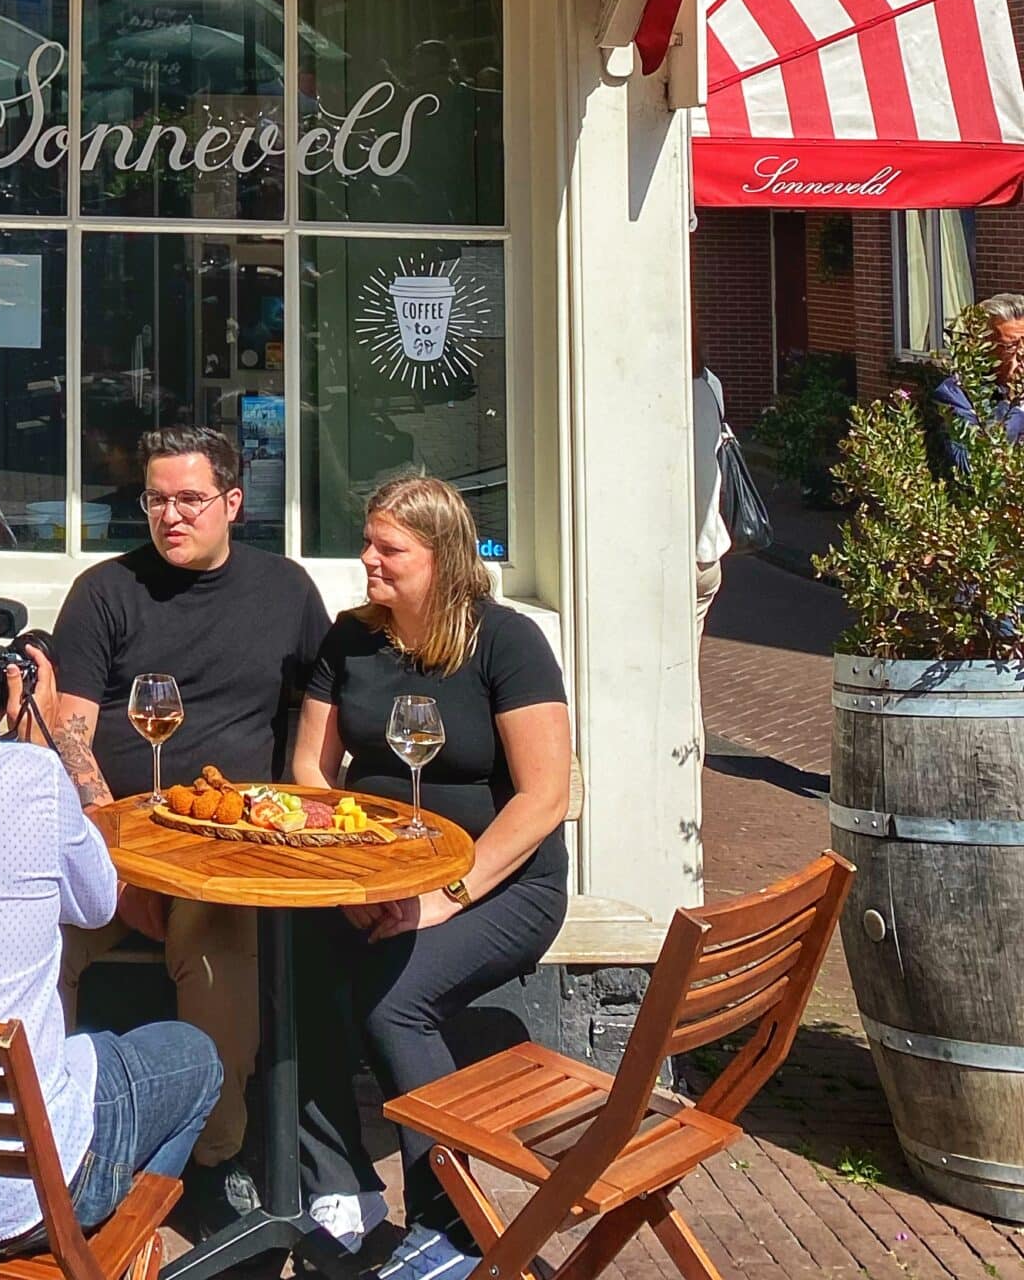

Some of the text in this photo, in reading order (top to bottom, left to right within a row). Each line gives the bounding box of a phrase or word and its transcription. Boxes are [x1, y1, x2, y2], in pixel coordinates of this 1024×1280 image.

[742, 155, 902, 196] Sonneveld
[402, 301, 444, 320] COFFEE
[414, 322, 431, 335] to
[413, 337, 437, 356] go
